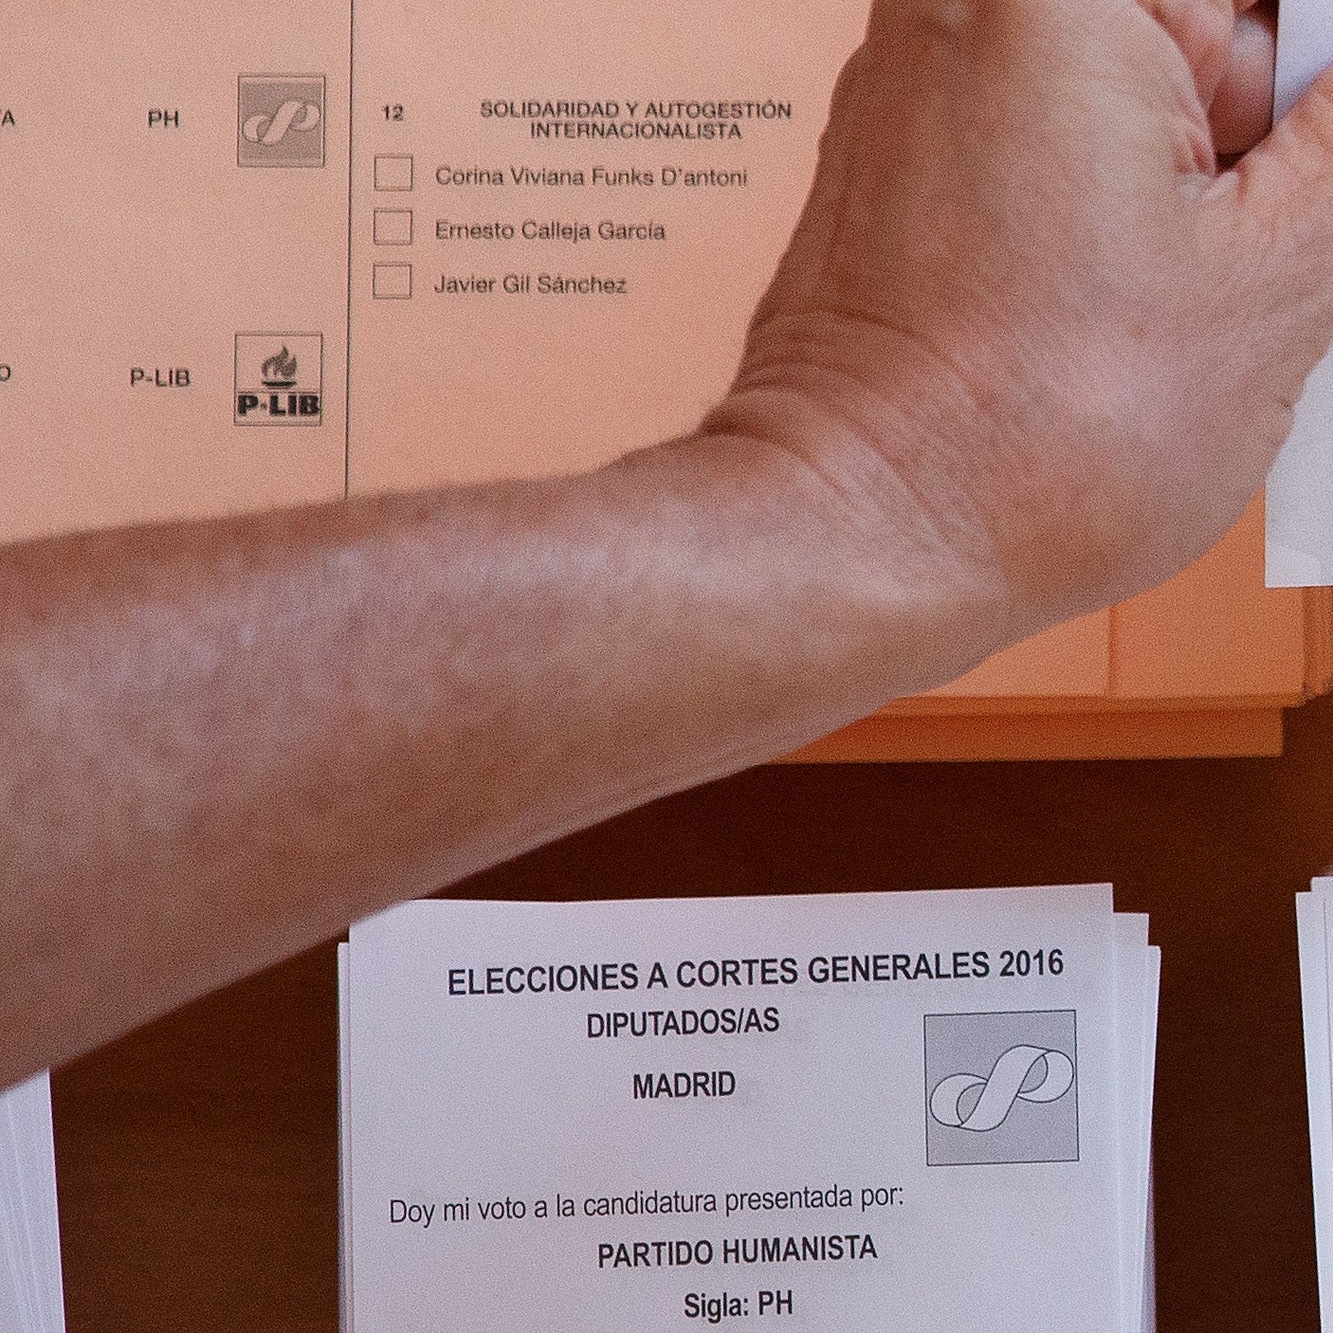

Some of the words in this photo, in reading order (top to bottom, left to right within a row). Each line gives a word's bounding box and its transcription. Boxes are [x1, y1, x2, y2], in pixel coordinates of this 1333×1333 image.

[146, 108, 181, 129] PH
[480, 99, 621, 122] SOLIDARIDAD
[625, 101, 639, 118] Y
[644, 97, 794, 122] AUTOGESTIÓN
[529, 119, 743, 140] INTERNACIONALISTA
[129, 366, 192, 389] P-LIB
[236, 391, 322, 417] P-LIB
[447, 961, 640, 996] ELECCIONES
[646, 961, 669, 990] A
[675, 956, 800, 989] CORTES
[806, 949, 991, 985] GENERALES
[998, 947, 1065, 979] 2016
[586, 1005, 781, 1039] DIPUTADOS/AS
[632, 1069, 737, 1100] MADRID
[388, 1197, 437, 1230] Doy
[441, 1196, 471, 1222] mi
[476, 1196, 529, 1221] voto
[532, 1198, 550, 1220] a
[555, 1192, 577, 1219] la
[581, 1189, 719, 1219] candidatura
[724, 1183, 854, 1218] presentada
[859, 1186, 903, 1213] por:
[597, 1238, 715, 1269] PARTIDO
[722, 1233, 878, 1265] HUMANISTA
[683, 1291, 749, 1325] Sigla:
[757, 1289, 794, 1316] PH
